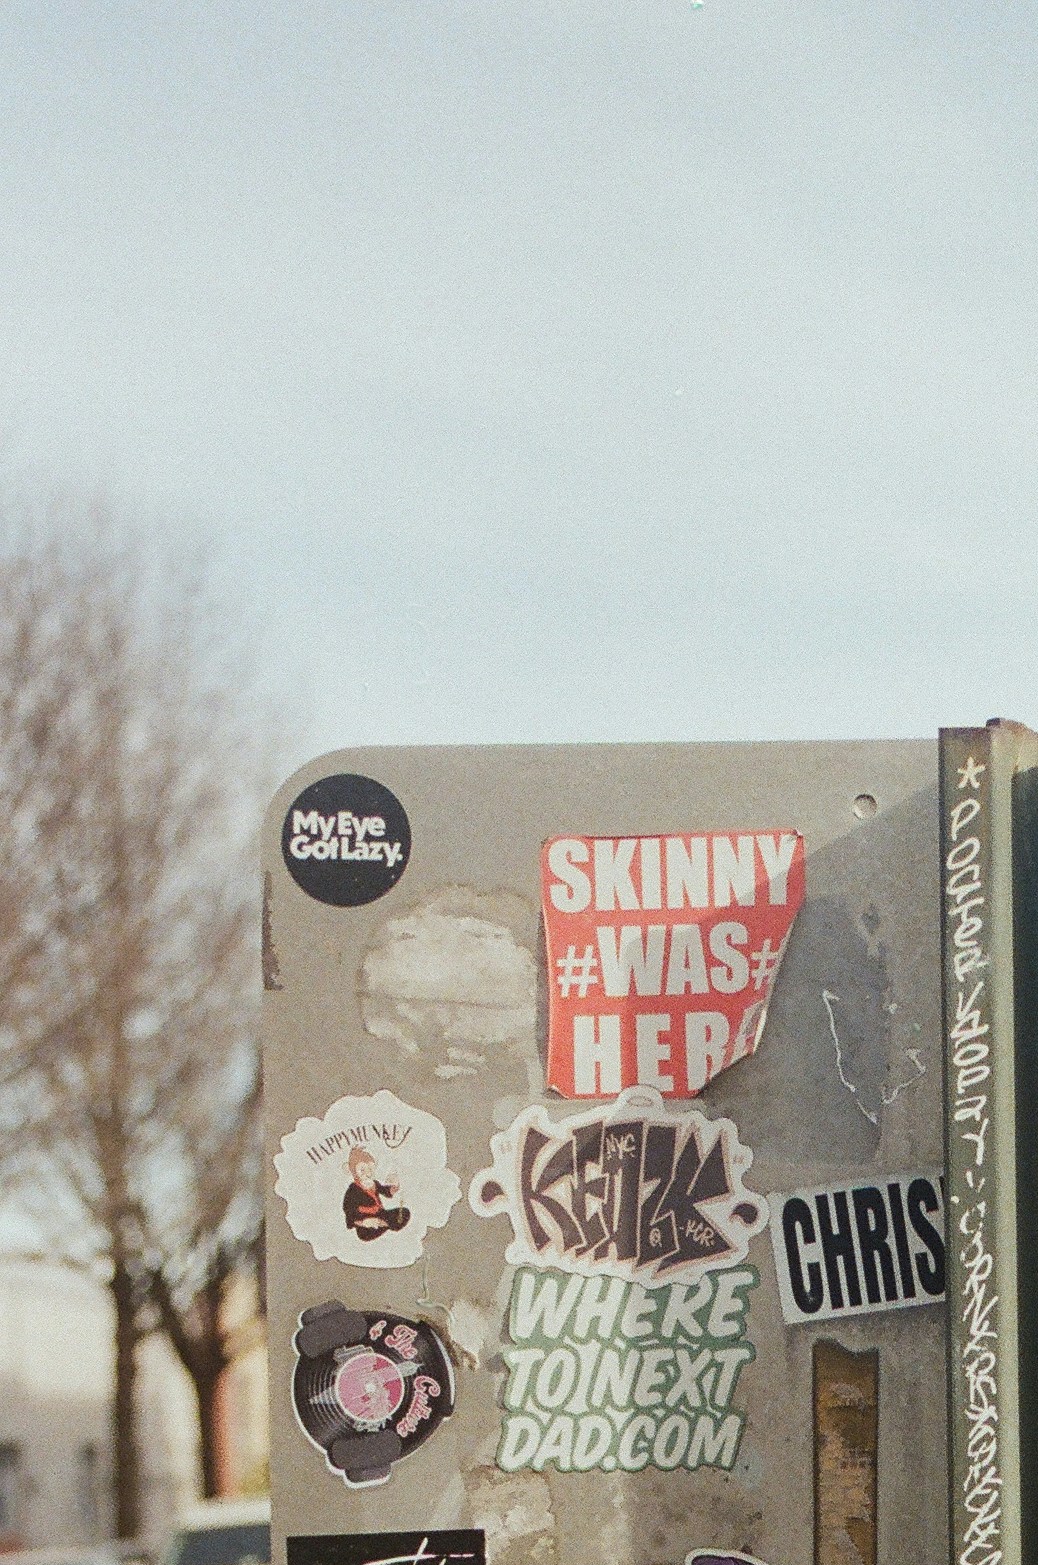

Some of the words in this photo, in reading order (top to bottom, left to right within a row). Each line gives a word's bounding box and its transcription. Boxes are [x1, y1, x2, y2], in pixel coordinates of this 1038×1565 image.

[289, 834, 339, 860] Got
[341, 836, 404, 868] Lazy.
[292, 809, 336, 841] My
[337, 810, 387, 844] Eye
[548, 834, 797, 914] SKINNY
[782, 1177, 946, 1314] CHRIS
[514, 1270, 755, 1339] WHERE
[508, 1347, 578, 1409] TO
[590, 1346, 754, 1409] NEXT
[498, 1413, 744, 1471] DAD.COM
